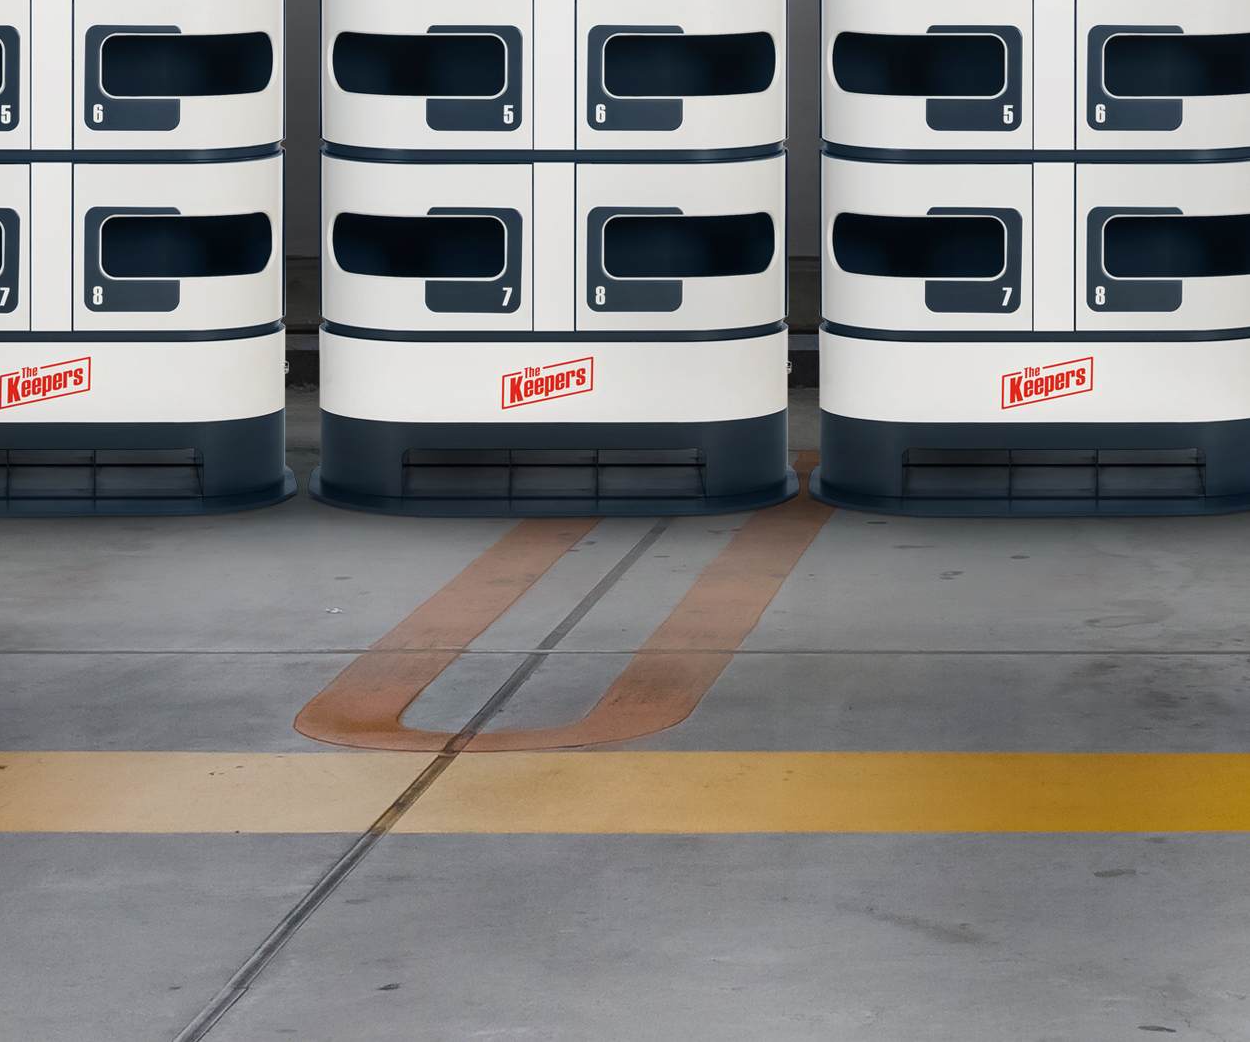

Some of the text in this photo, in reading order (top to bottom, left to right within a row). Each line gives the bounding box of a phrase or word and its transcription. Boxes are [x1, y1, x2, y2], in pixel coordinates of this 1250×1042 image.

[0, 104, 11, 124] 5
[93, 104, 103, 124] 6
[503, 104, 514, 124] 5
[596, 104, 606, 124] 6
[1003, 104, 1014, 124] 5
[1096, 104, 1106, 124] 6
[0, 287, 10, 307] 7
[92, 286, 103, 306] 8
[502, 287, 513, 307] 7
[595, 286, 606, 306] 8
[1002, 287, 1013, 307] 7
[1095, 286, 1106, 306] 8
[21, 366, 38, 378] The
[524, 366, 542, 378] The
[1023, 366, 1041, 378] The
[7, 368, 84, 404] Keepers
[510, 368, 587, 404] Keepers
[1009, 368, 1086, 404] Keepers
